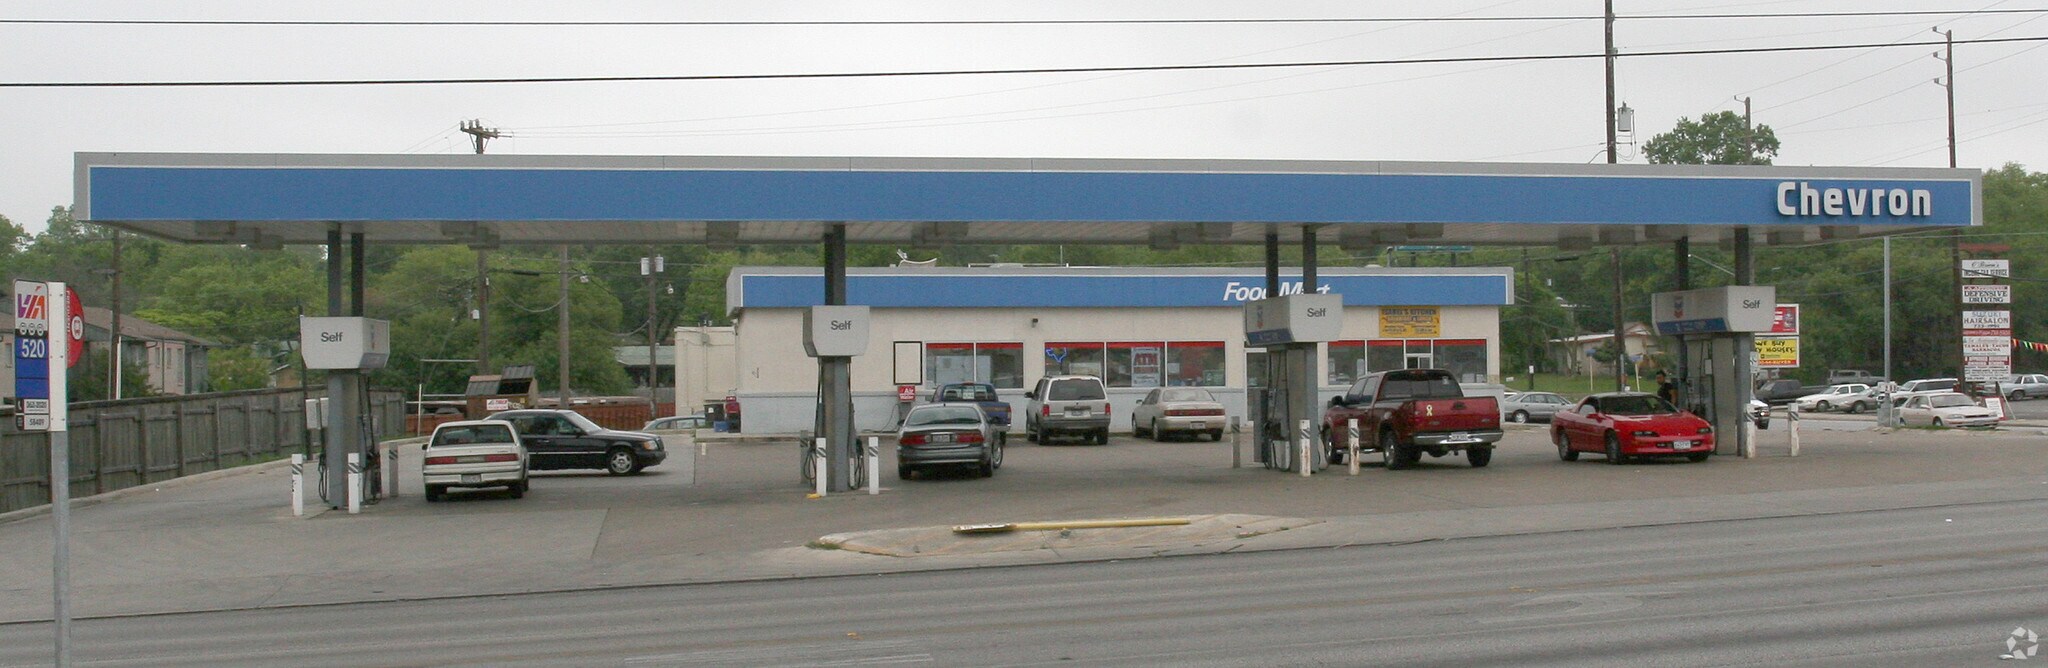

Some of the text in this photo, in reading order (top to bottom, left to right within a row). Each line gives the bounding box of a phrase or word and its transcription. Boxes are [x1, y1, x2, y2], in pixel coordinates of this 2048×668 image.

[1777, 181, 1931, 216] Chevron
[1743, 300, 1760, 309] Self
[1307, 308, 1326, 318] Self
[831, 320, 852, 331] Self
[321, 331, 343, 342] Self
[21, 338, 45, 358] 520
